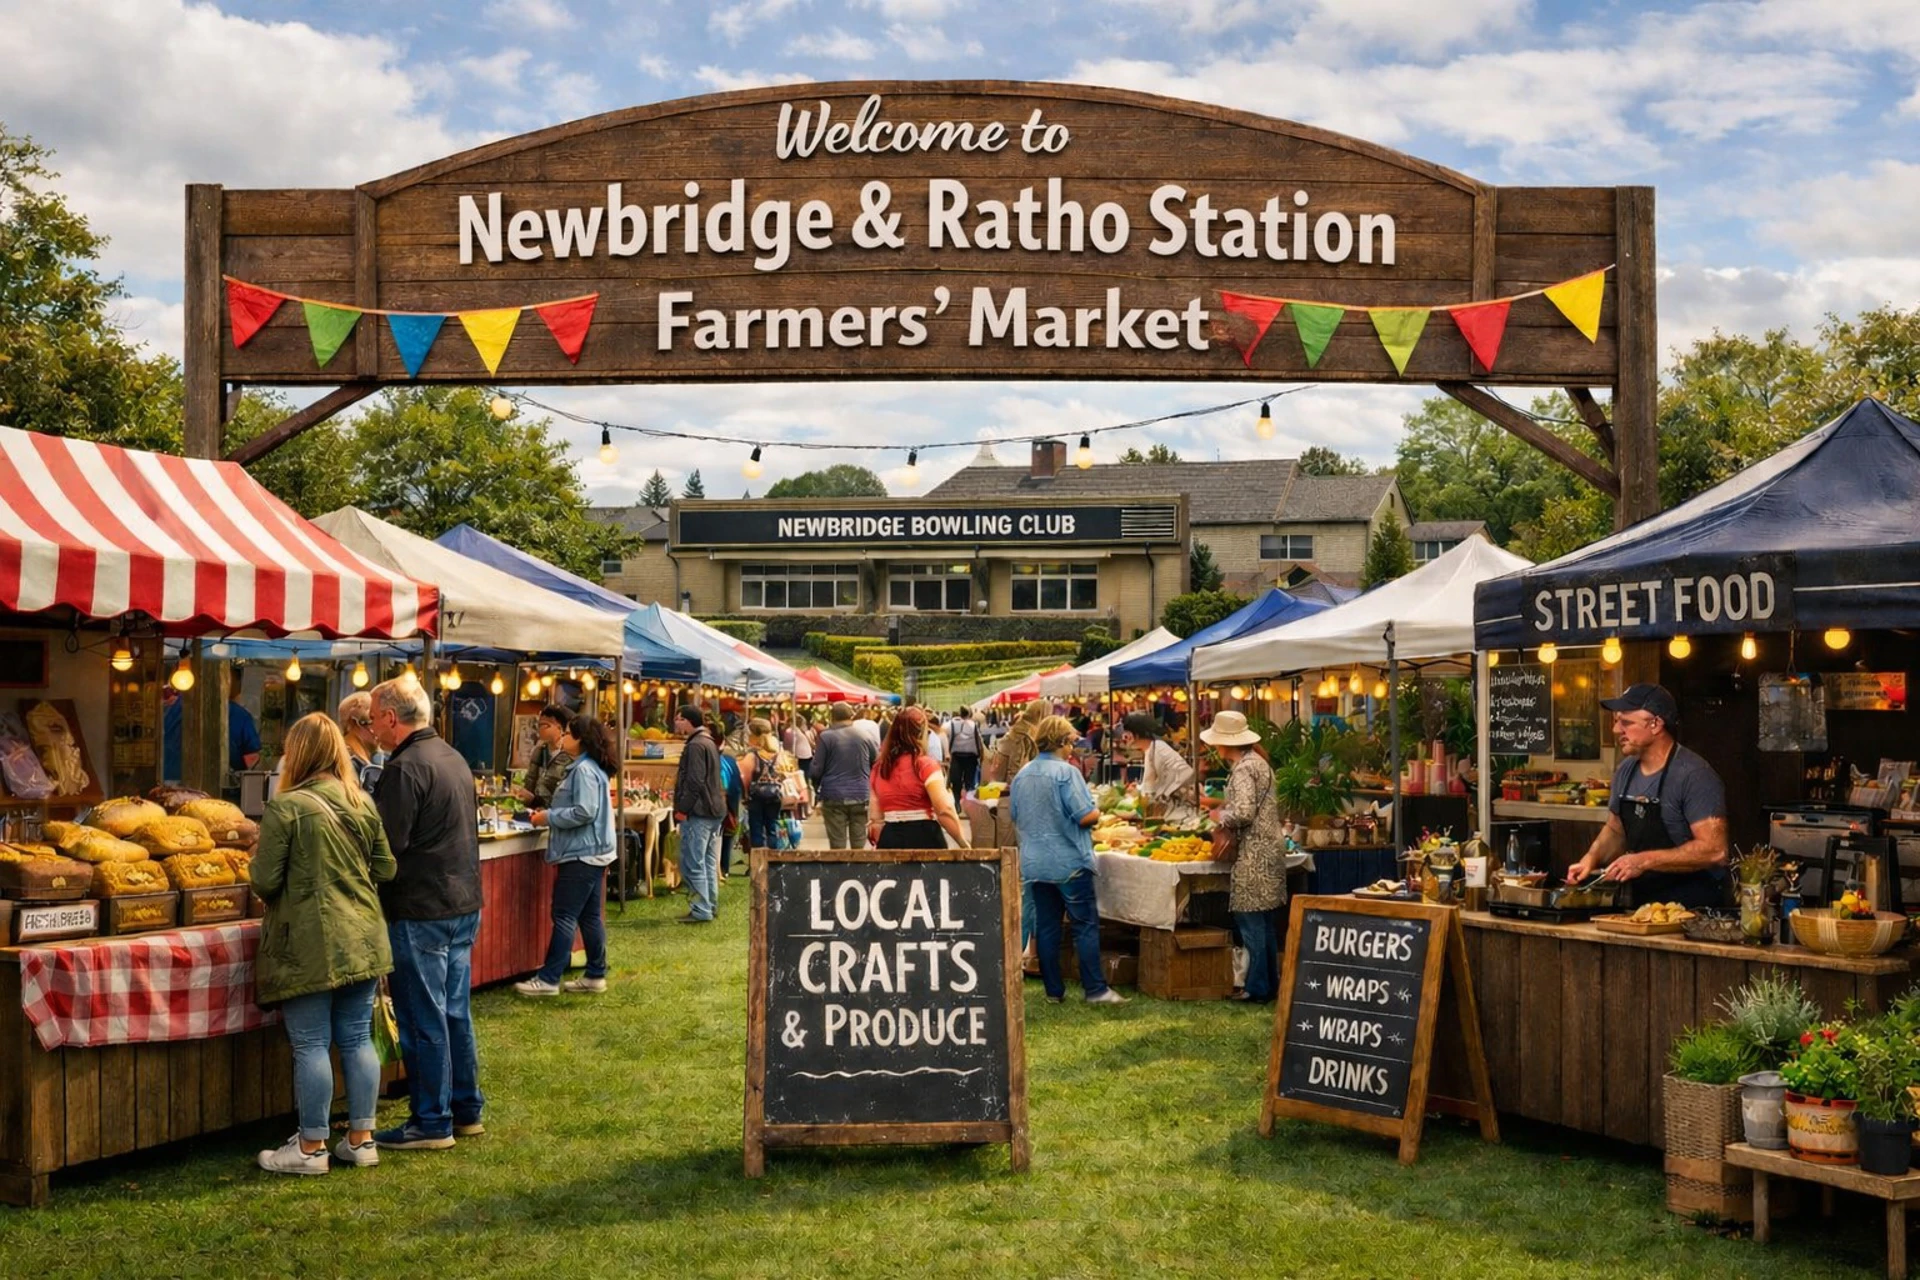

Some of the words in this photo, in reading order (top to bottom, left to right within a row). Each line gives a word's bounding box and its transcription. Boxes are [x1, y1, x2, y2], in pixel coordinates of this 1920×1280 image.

[775, 94, 1008, 160] Welcome
[1020, 108, 1070, 154] to
[458, 178, 834, 271] Newbridge
[850, 180, 905, 250] &
[928, 177, 1130, 254] Ratho
[1148, 184, 1396, 265] Station
[656, 286, 951, 352] Farmers’
[968, 286, 1211, 352] Market
[777, 516, 905, 538] NEWBRIDGE
[911, 515, 1012, 536] BOWLING
[1018, 514, 1076, 535] CLUB
[1534, 580, 1662, 632] STREET
[1674, 571, 1775, 623] FOOD
[809, 878, 965, 931] LOCAL
[798, 940, 978, 993] CRAFTS
[1314, 925, 1414, 962] BURGERS
[1326, 974, 1390, 1005] WRAPS
[780, 1009, 808, 1049] &
[824, 1003, 988, 1047] PRODUCE
[1319, 1015, 1383, 1048] WRAPS
[1308, 1056, 1389, 1096] DRINKS
